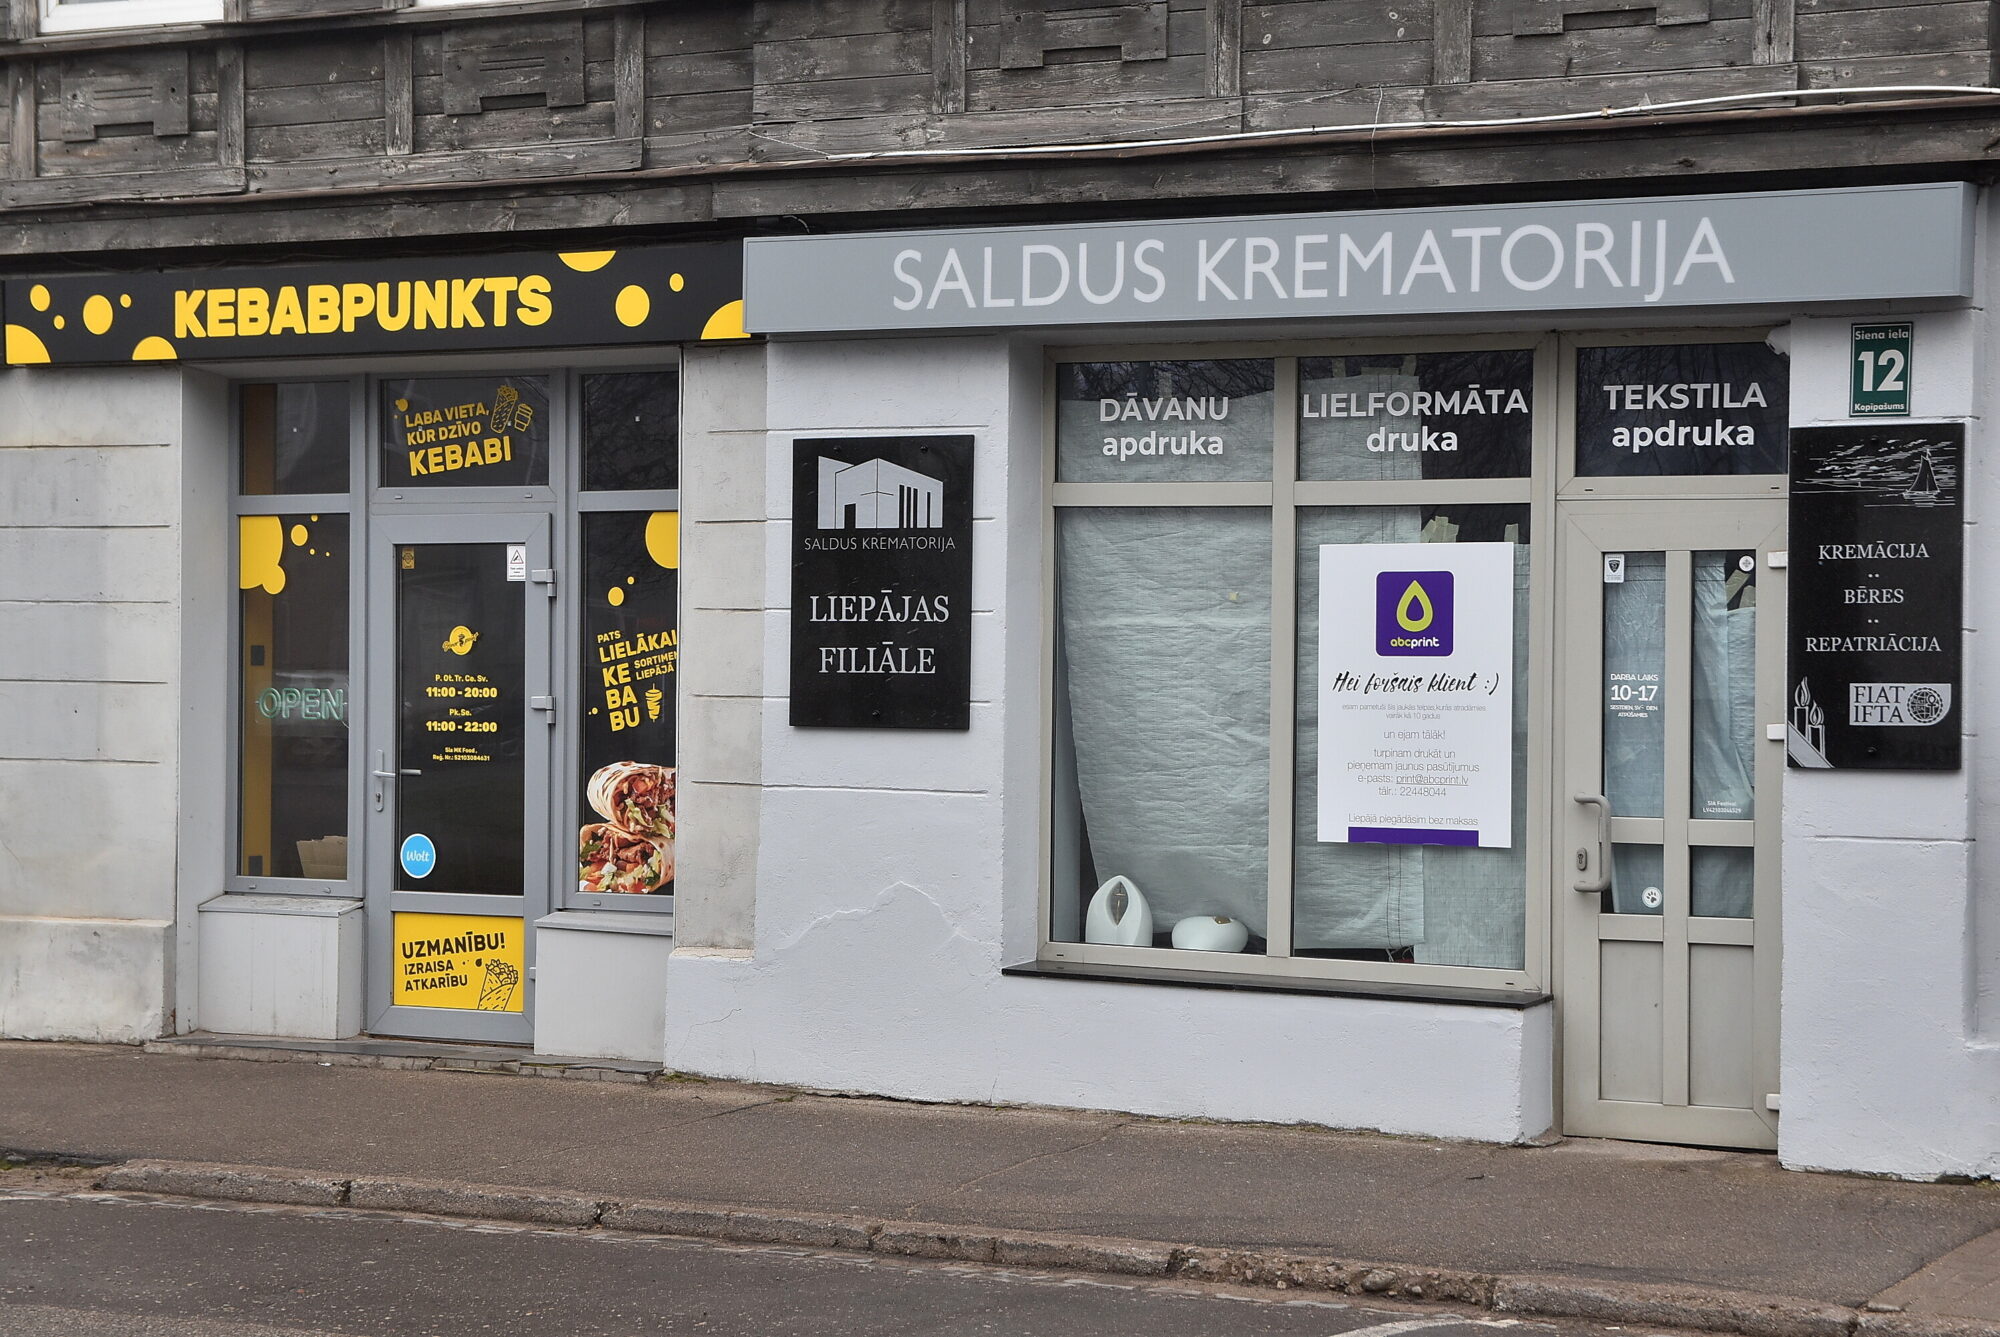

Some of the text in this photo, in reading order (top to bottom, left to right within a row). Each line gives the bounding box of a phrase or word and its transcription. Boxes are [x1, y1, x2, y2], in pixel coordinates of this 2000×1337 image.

[893, 216, 1737, 312] SALDUS KREMATORIJA
[174, 274, 553, 340] KEBABPUNKTS
[1855, 328, 1909, 340] Siena iela
[1858, 349, 1905, 391] 12
[1303, 384, 1529, 419] LIELFORMĀTA
[1603, 382, 1768, 410] TEKSTILA
[405, 402, 490, 428] LABA VIETA,
[1099, 392, 1230, 422] DĀVANU
[439, 421, 481, 441] DZĪVO
[1366, 426, 1458, 452] druka
[1612, 418, 1755, 453] apdruka
[409, 435, 511, 477] KEBABI
[1102, 431, 1224, 462] apdruka
[804, 536, 956, 552] SALDUS KREMATORIJA
[1818, 541, 1930, 560] KREMĀCIJA
[1844, 586, 1904, 604] BĒRES
[809, 590, 950, 623] LIEPĀJAS
[597, 630, 622, 643] PATS
[1390, 636, 1440, 649] abcprint
[1805, 633, 1942, 652] REPATRIĀCIJA
[818, 641, 936, 674] FILIĀLE
[602, 662, 632, 688] KE
[636, 662, 675, 680] LIEPĀJĀ
[1332, 671, 1361, 692] Hei
[1364, 671, 1424, 694] foršais
[1427, 671, 1478, 692] klient
[426, 687, 456, 697] 11:00
[464, 687, 498, 698] 20:00
[605, 685, 638, 710] BA
[1610, 684, 1659, 701] 10-17
[1853, 686, 1905, 704] FIAT
[259, 687, 344, 720] OPEN
[609, 706, 640, 732] BU
[1853, 704, 1905, 723] IFTA
[426, 721, 456, 732] 11:00
[464, 722, 498, 732] 22:00
[1383, 731, 1395, 739] un
[1397, 730, 1420, 741] ejam
[1413, 748, 1442, 759] drukāt
[1444, 750, 1456, 758] un
[1395, 762, 1424, 771] jaunus
[1399, 787, 1447, 797] 22448044
[1428, 816, 1444, 824] bez
[1445, 817, 1479, 826] maksas
[406, 850, 430, 862] Wolt
[402, 931, 506, 959] UZMANĪBU!
[404, 959, 454, 975] IZRAISA
[405, 973, 468, 992] ATKARĪBU
